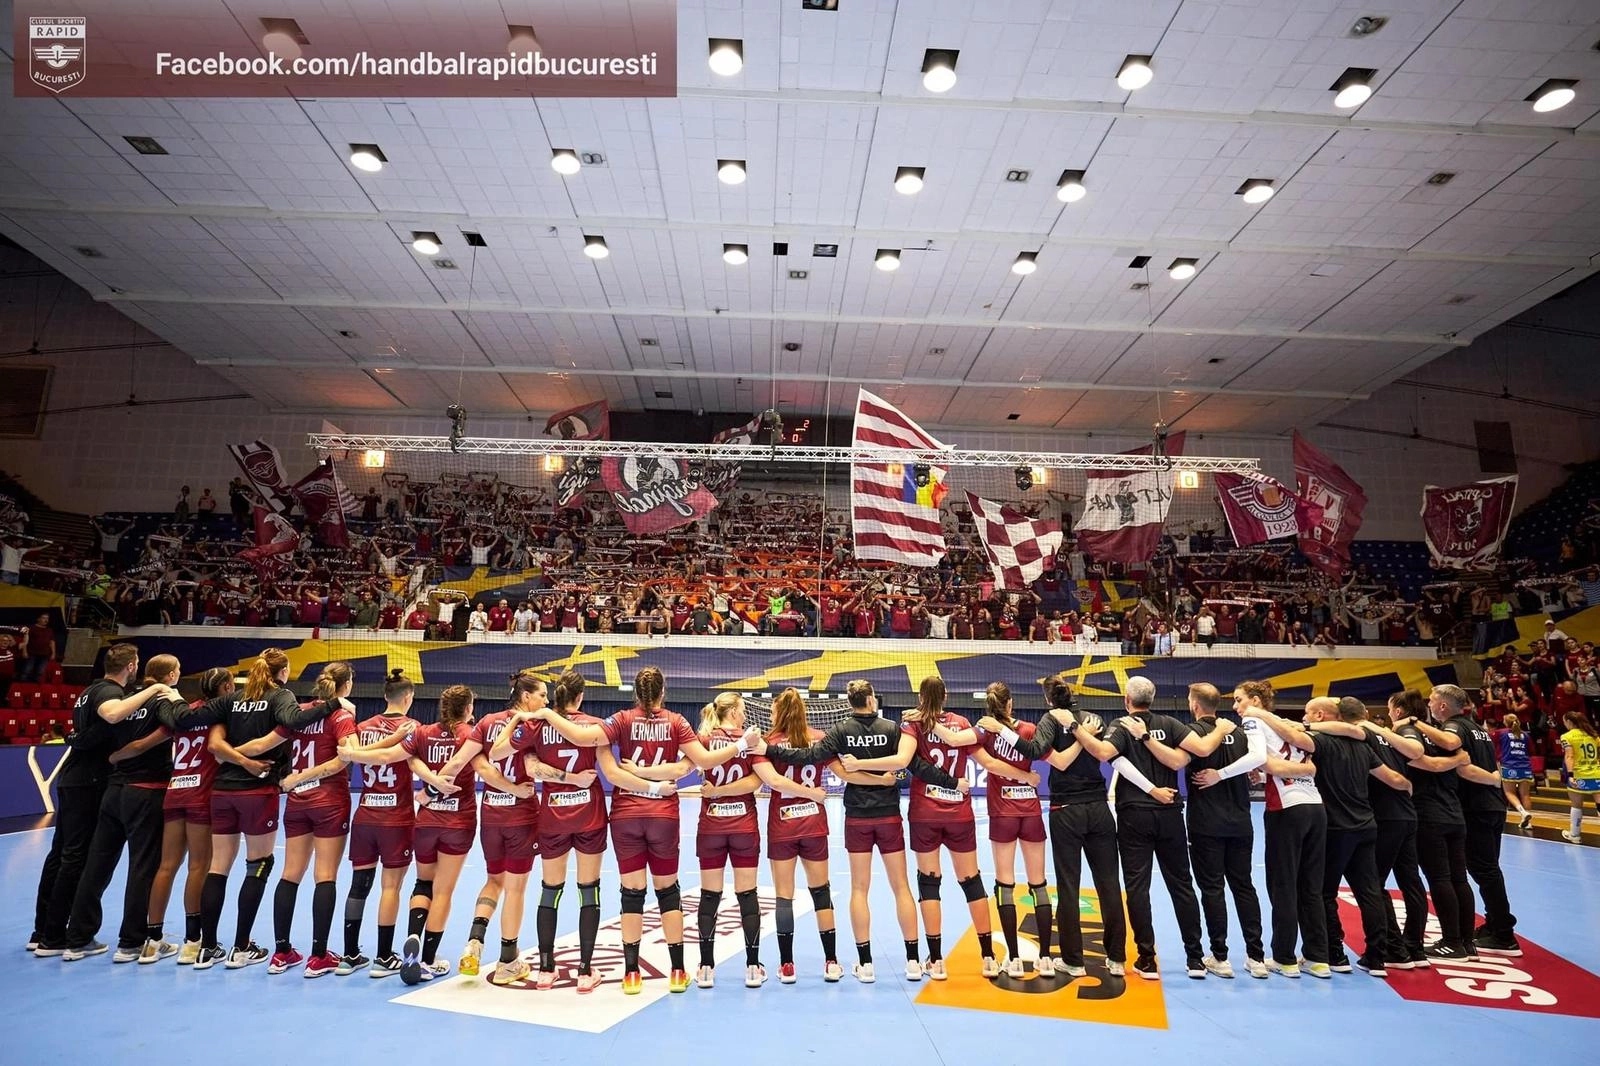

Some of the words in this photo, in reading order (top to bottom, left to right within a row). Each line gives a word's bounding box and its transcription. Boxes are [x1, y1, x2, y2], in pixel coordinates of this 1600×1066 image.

[1266, 519, 1298, 536] 1923
[232, 700, 269, 713] RAPID
[846, 734, 888, 748] RAPID
[173, 735, 207, 771] 22
[427, 742, 456, 765] LÓPEZ
[1579, 742, 1596, 760] 19
[557, 748, 579, 774] 7
[363, 763, 398, 788] 34
[711, 763, 745, 787] 20
[559, 791, 588, 800] THERMO
[717, 803, 744, 811] THERMO
[791, 803, 816, 812] THERMO
